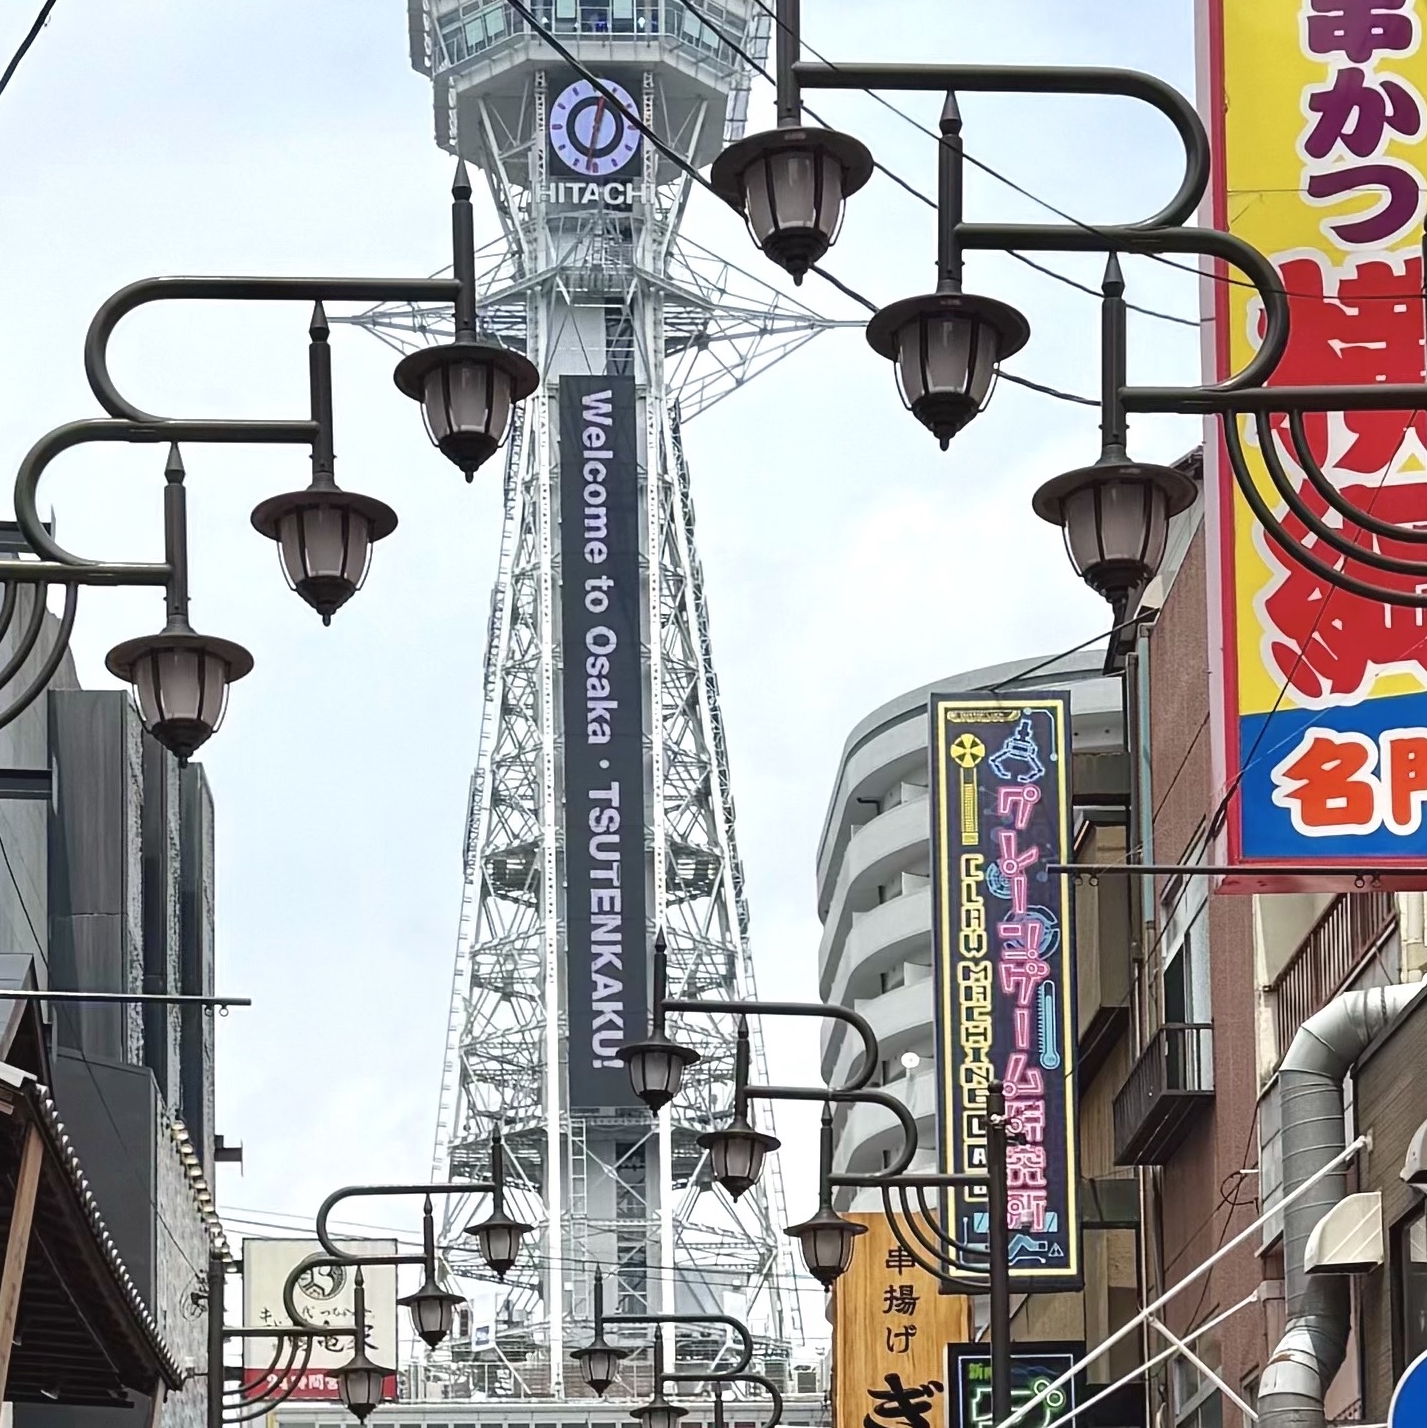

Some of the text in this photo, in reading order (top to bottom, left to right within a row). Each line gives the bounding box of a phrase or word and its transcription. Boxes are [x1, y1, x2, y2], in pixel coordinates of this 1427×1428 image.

[538, 182, 657, 205] HITACHI
[582, 389, 624, 1069] Welcome to Osaka TSUTENKAKU!
[960, 853, 985, 958] CLAW
[957, 961, 993, 1110] MACHINE
[884, 1244, 920, 1355] 串揚げ
